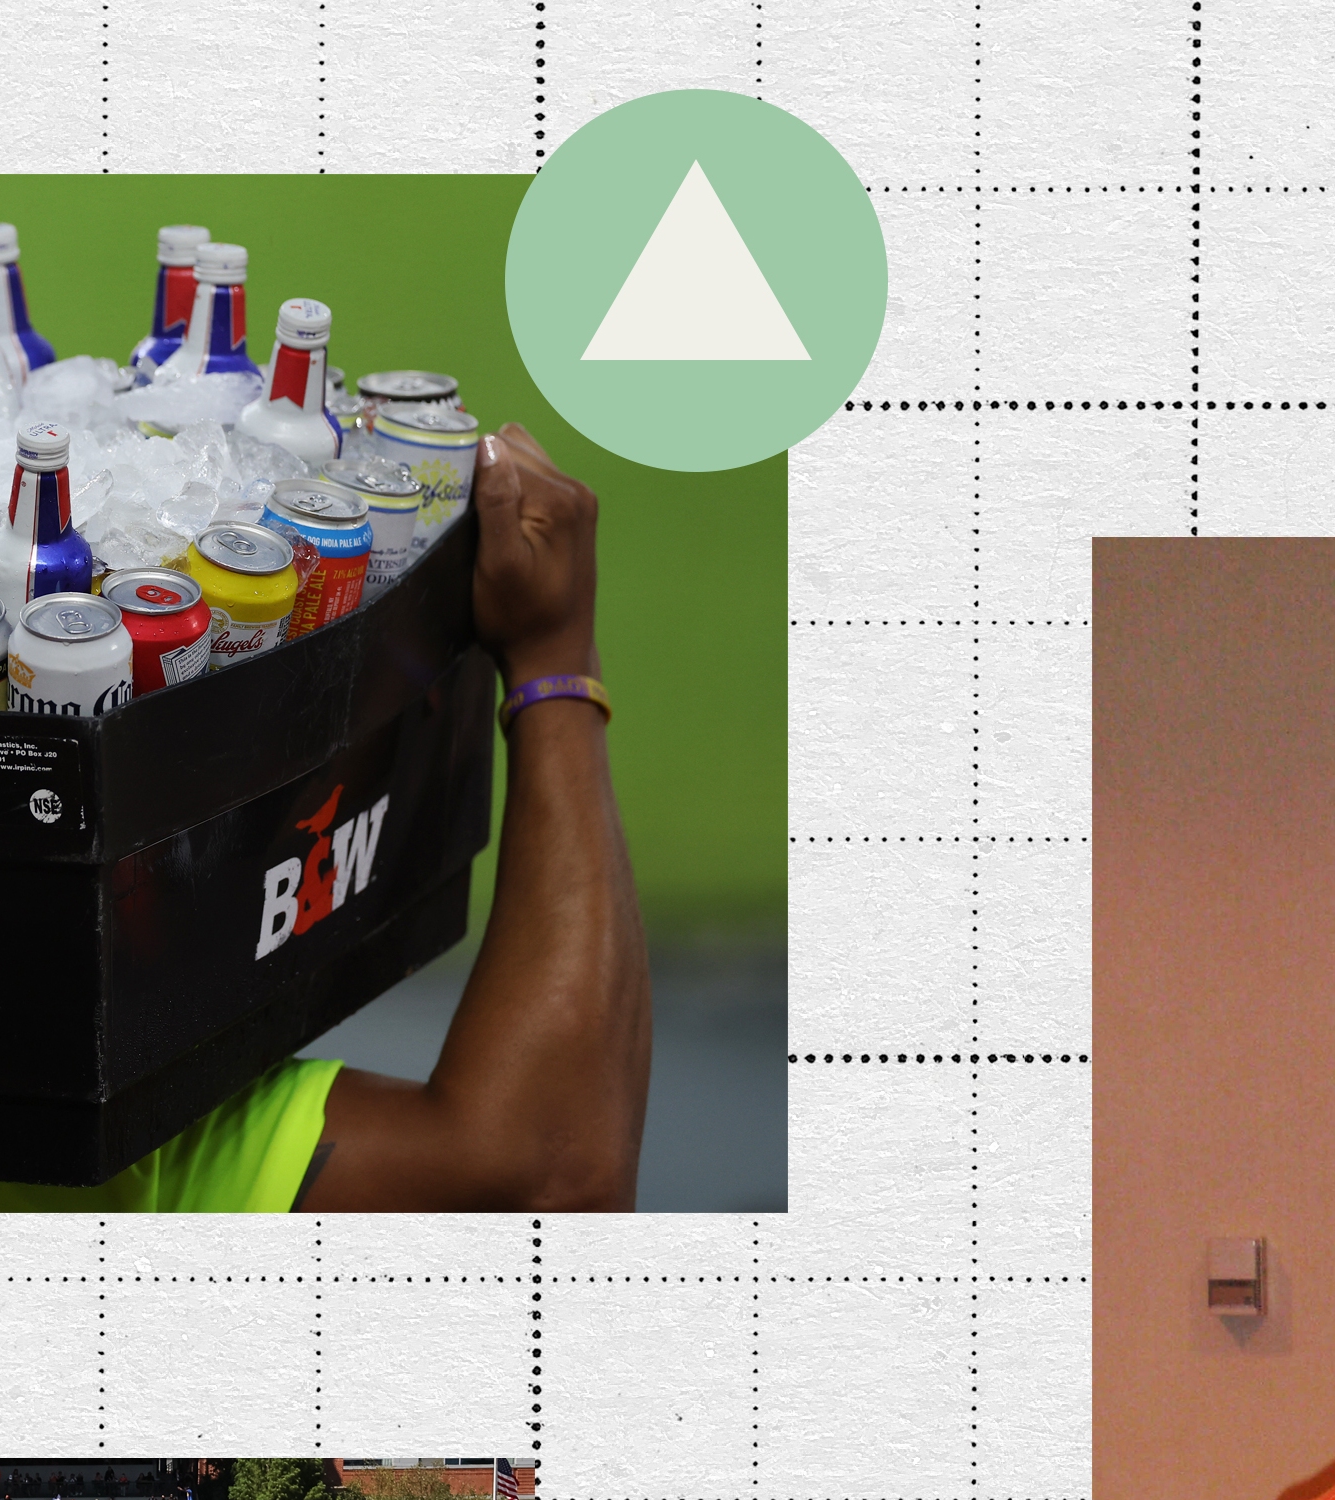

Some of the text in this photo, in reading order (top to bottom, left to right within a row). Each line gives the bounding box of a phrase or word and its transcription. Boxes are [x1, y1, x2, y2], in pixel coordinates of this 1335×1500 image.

[321, 537, 339, 548] INDIA
[339, 538, 353, 549] PALE
[354, 536, 362, 546] ALE
[303, 569, 327, 620] PALE ALE
[24, 742, 38, 750] Inc.
[255, 794, 390, 961] B&W
